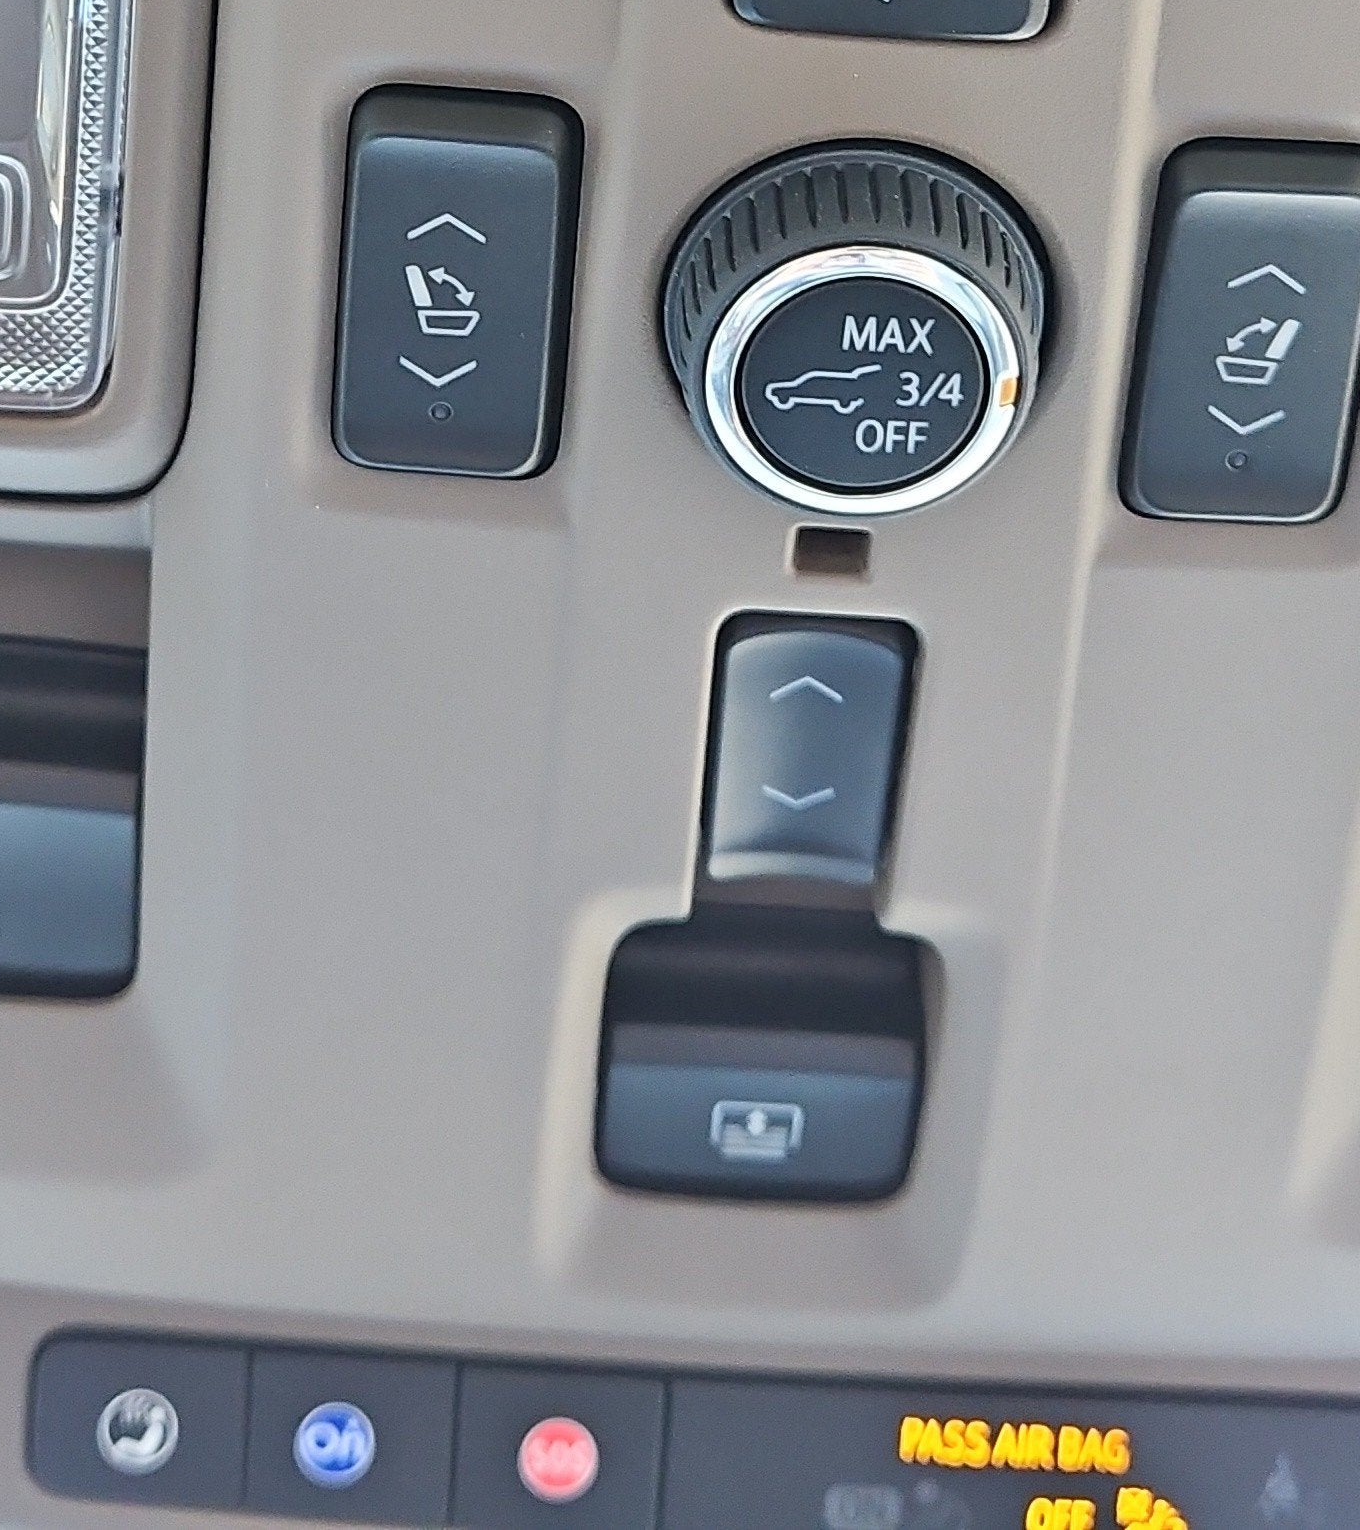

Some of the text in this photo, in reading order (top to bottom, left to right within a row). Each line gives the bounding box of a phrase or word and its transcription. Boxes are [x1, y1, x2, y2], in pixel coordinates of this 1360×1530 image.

[841, 315, 936, 357] MAX
[895, 371, 964, 408] 3/4
[855, 419, 930, 455] OFF
[898, 1416, 1131, 1475] PASS AIR BAG
[1025, 1497, 1097, 1530] OFF
